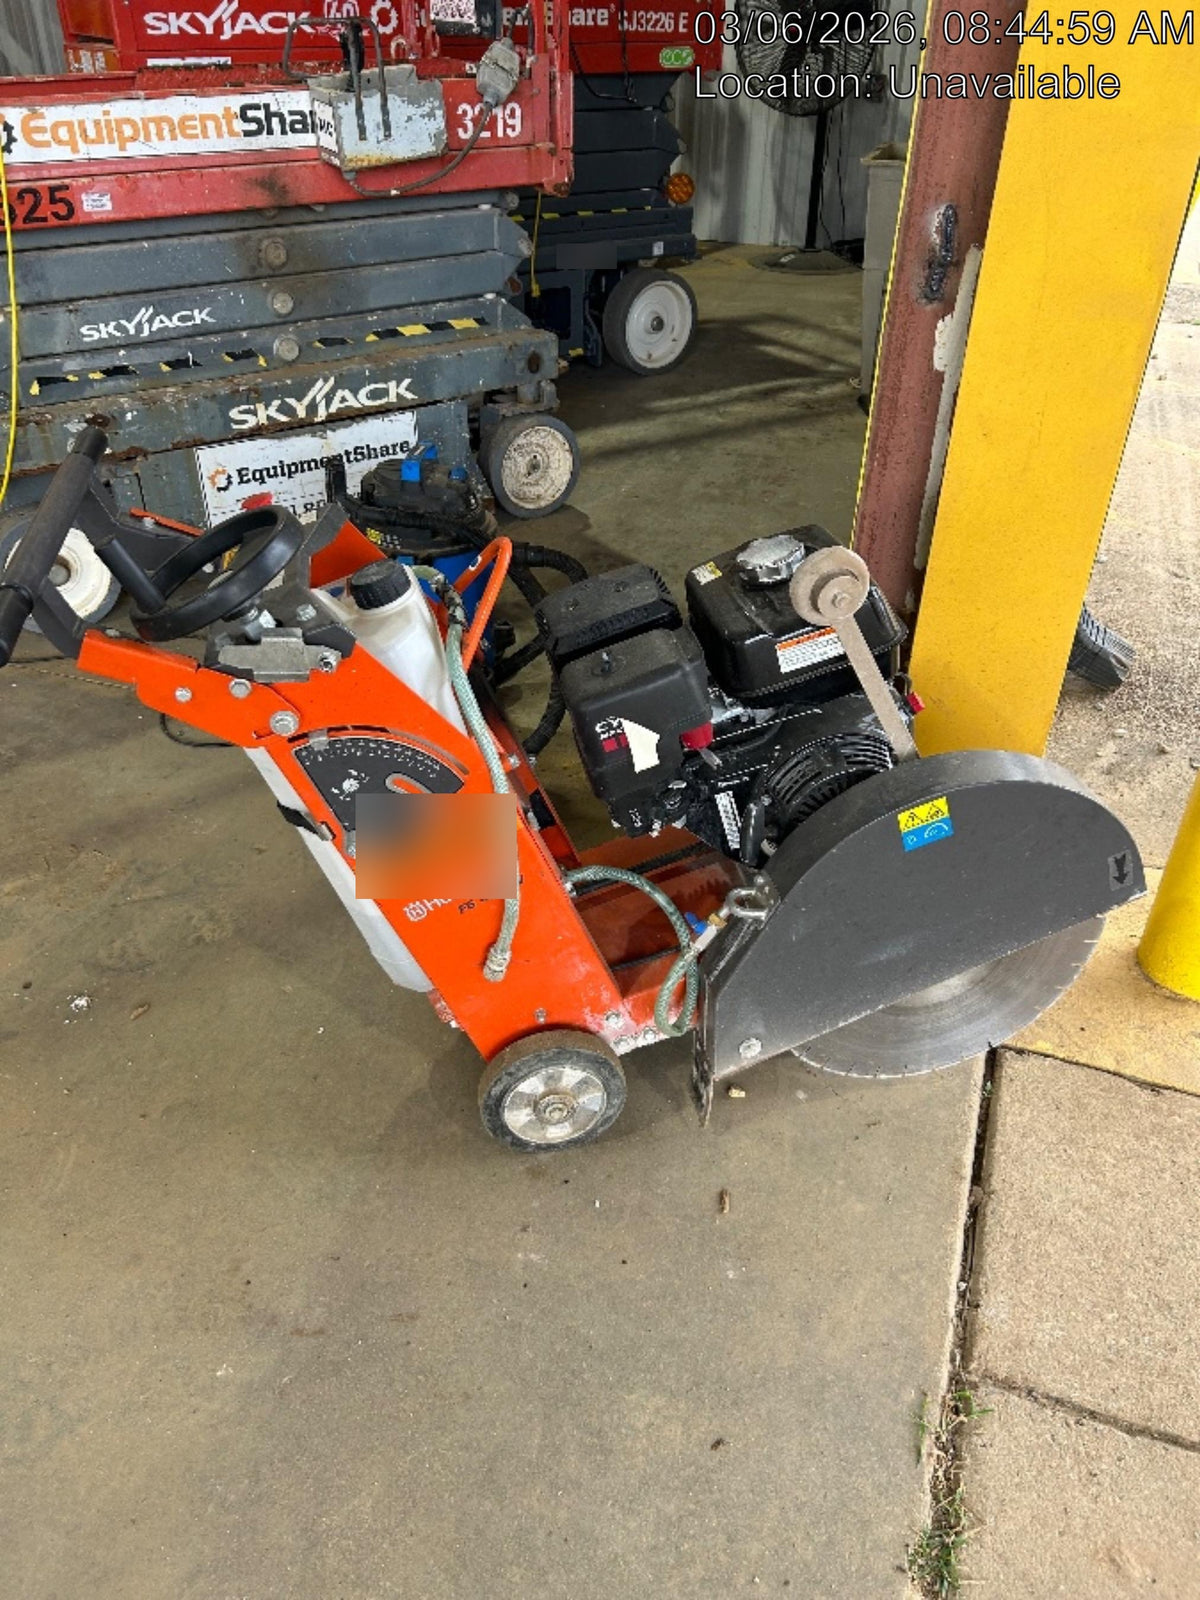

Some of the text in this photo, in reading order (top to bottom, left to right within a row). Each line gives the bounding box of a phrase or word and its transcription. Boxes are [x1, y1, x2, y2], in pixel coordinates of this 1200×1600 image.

[143, 0, 316, 40] SKYJACK
[679, 12, 689, 33] E
[456, 102, 522, 140] 3219
[79, 305, 217, 342] SKYJACK
[228, 376, 419, 430] SKYJACK
